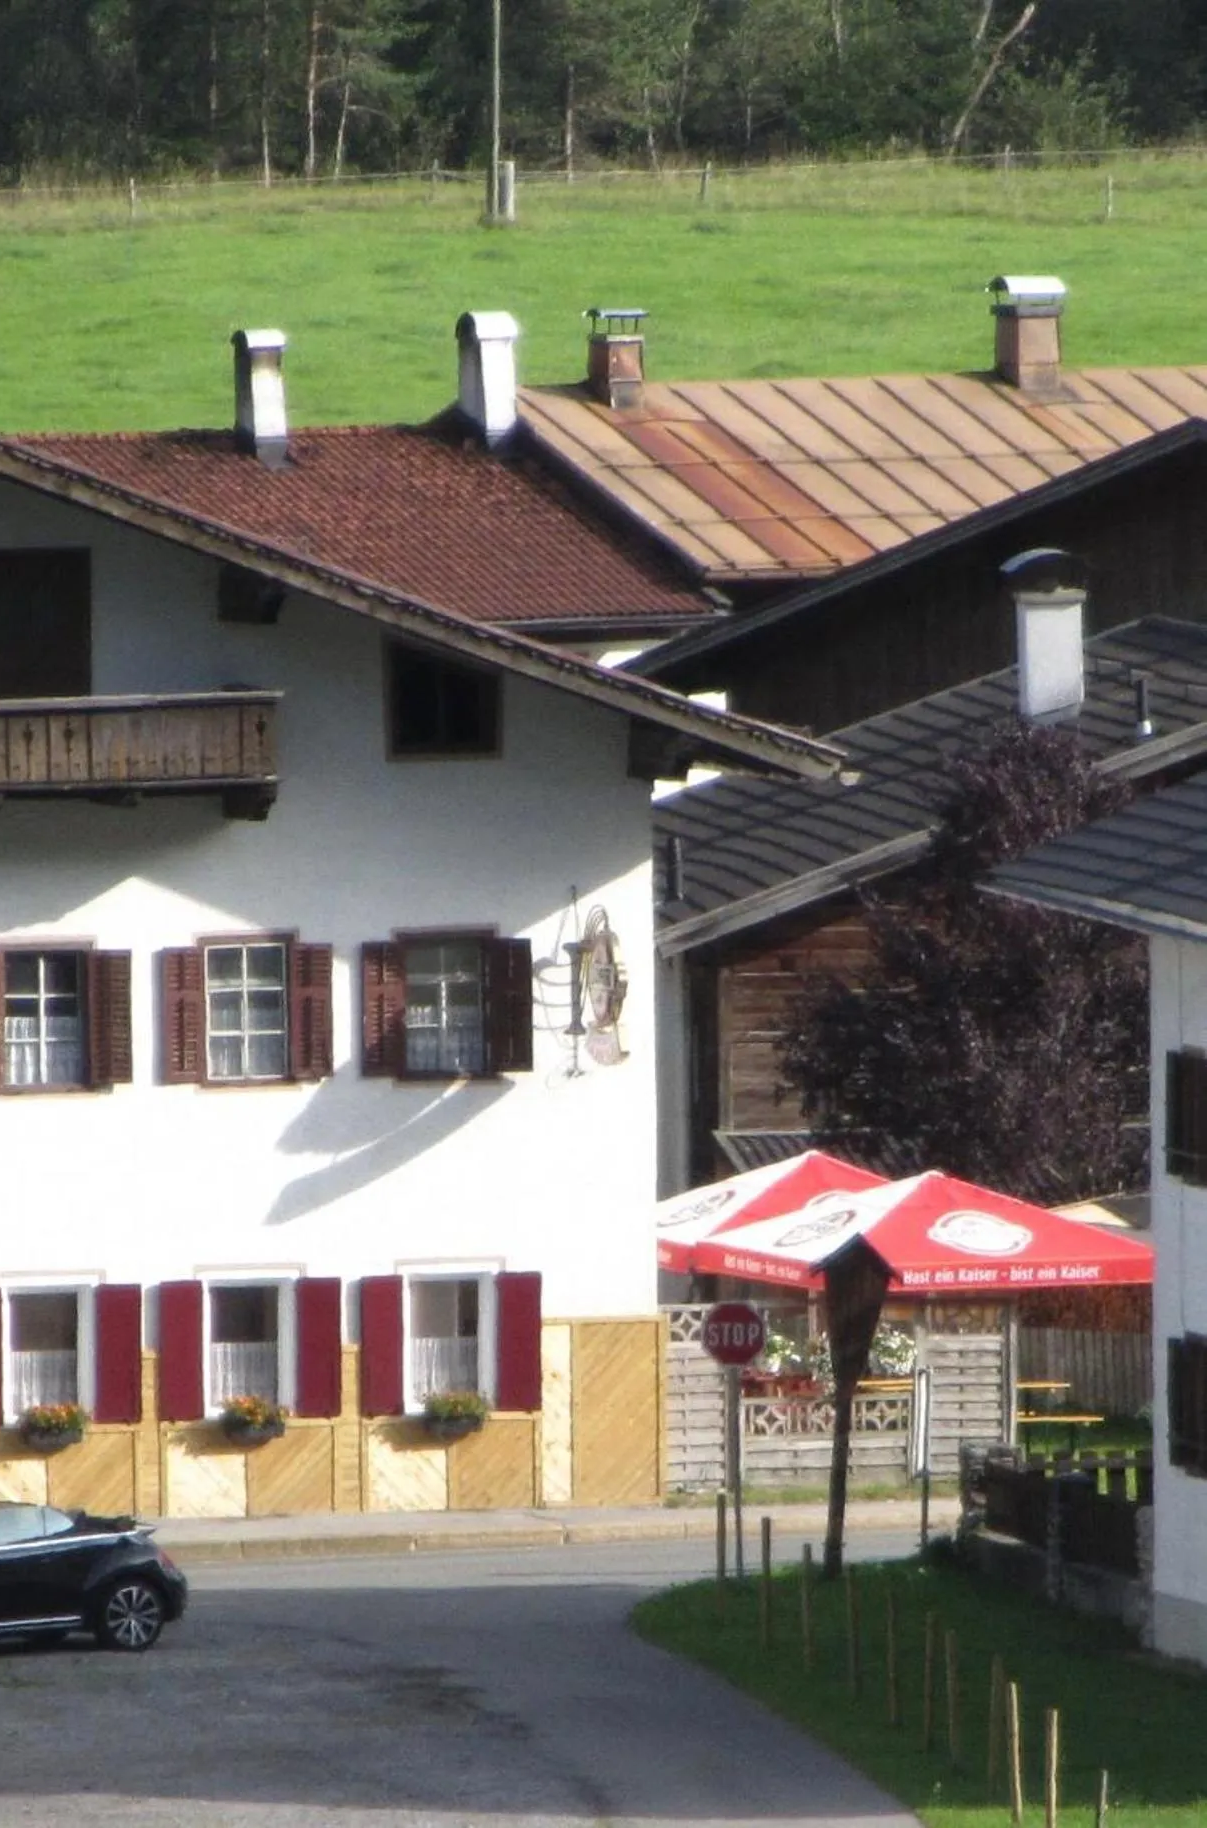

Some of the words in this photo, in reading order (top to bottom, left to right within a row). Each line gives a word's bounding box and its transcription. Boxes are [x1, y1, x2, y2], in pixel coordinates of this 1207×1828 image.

[958, 1267, 998, 1282] Kaiser
[1060, 1263, 1101, 1280] Kaiser
[708, 1321, 760, 1348] STOP
